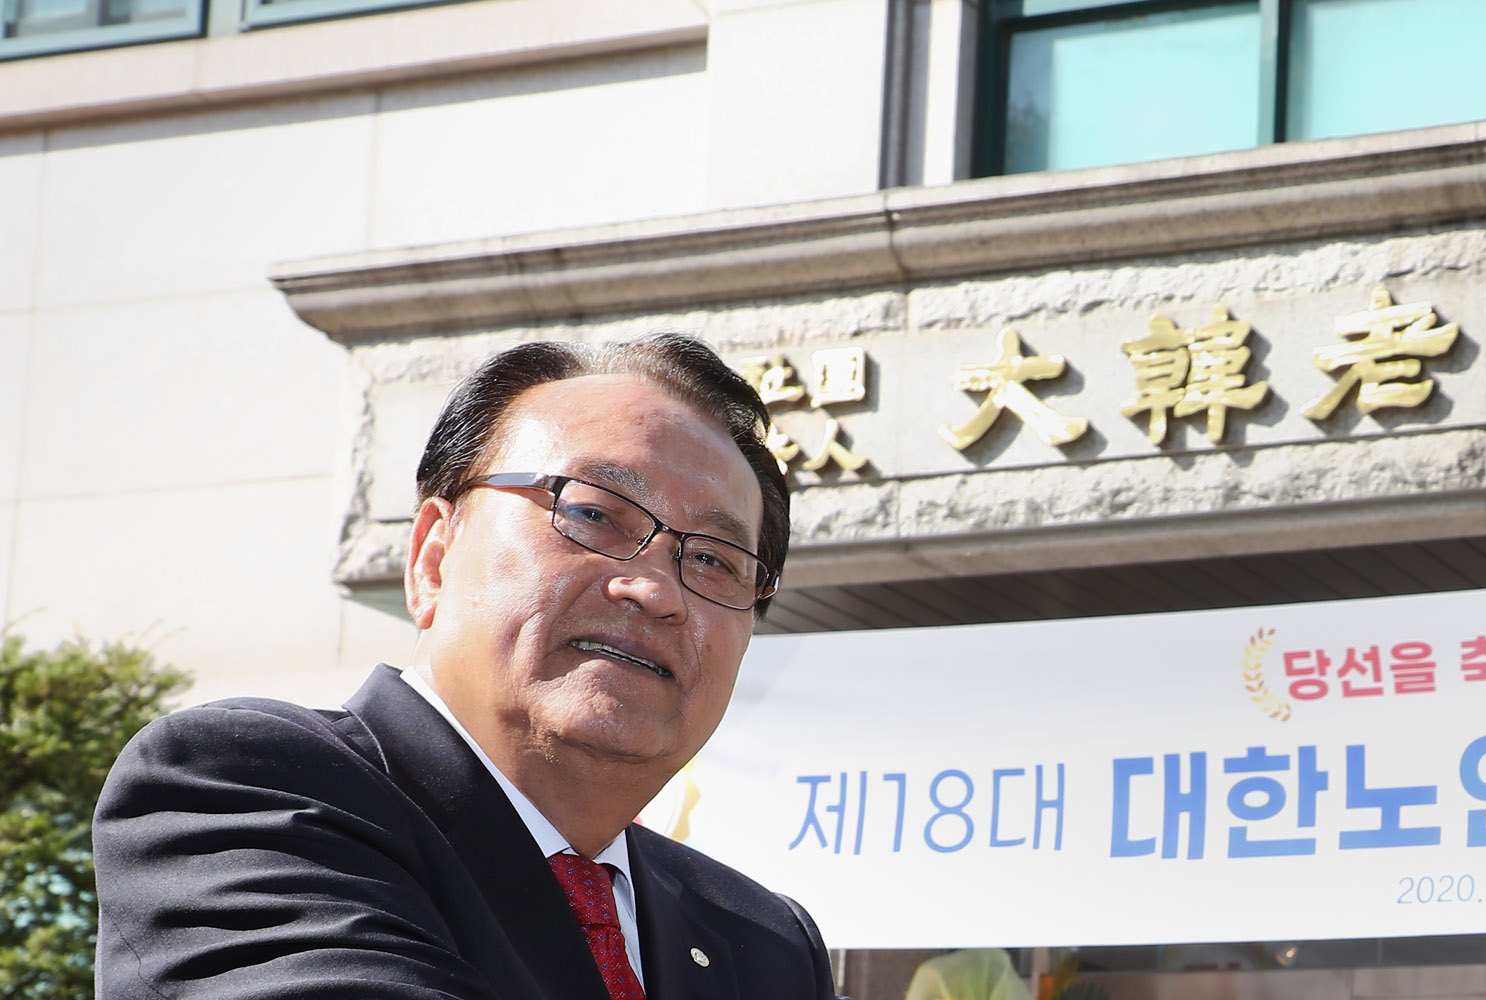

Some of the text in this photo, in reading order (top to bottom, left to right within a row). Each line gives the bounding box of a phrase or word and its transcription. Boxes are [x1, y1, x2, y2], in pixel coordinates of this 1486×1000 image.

[1282, 641, 1437, 701] 당선을
[788, 762, 1066, 855] 제18대
[1396, 874, 1483, 905] 2020.
